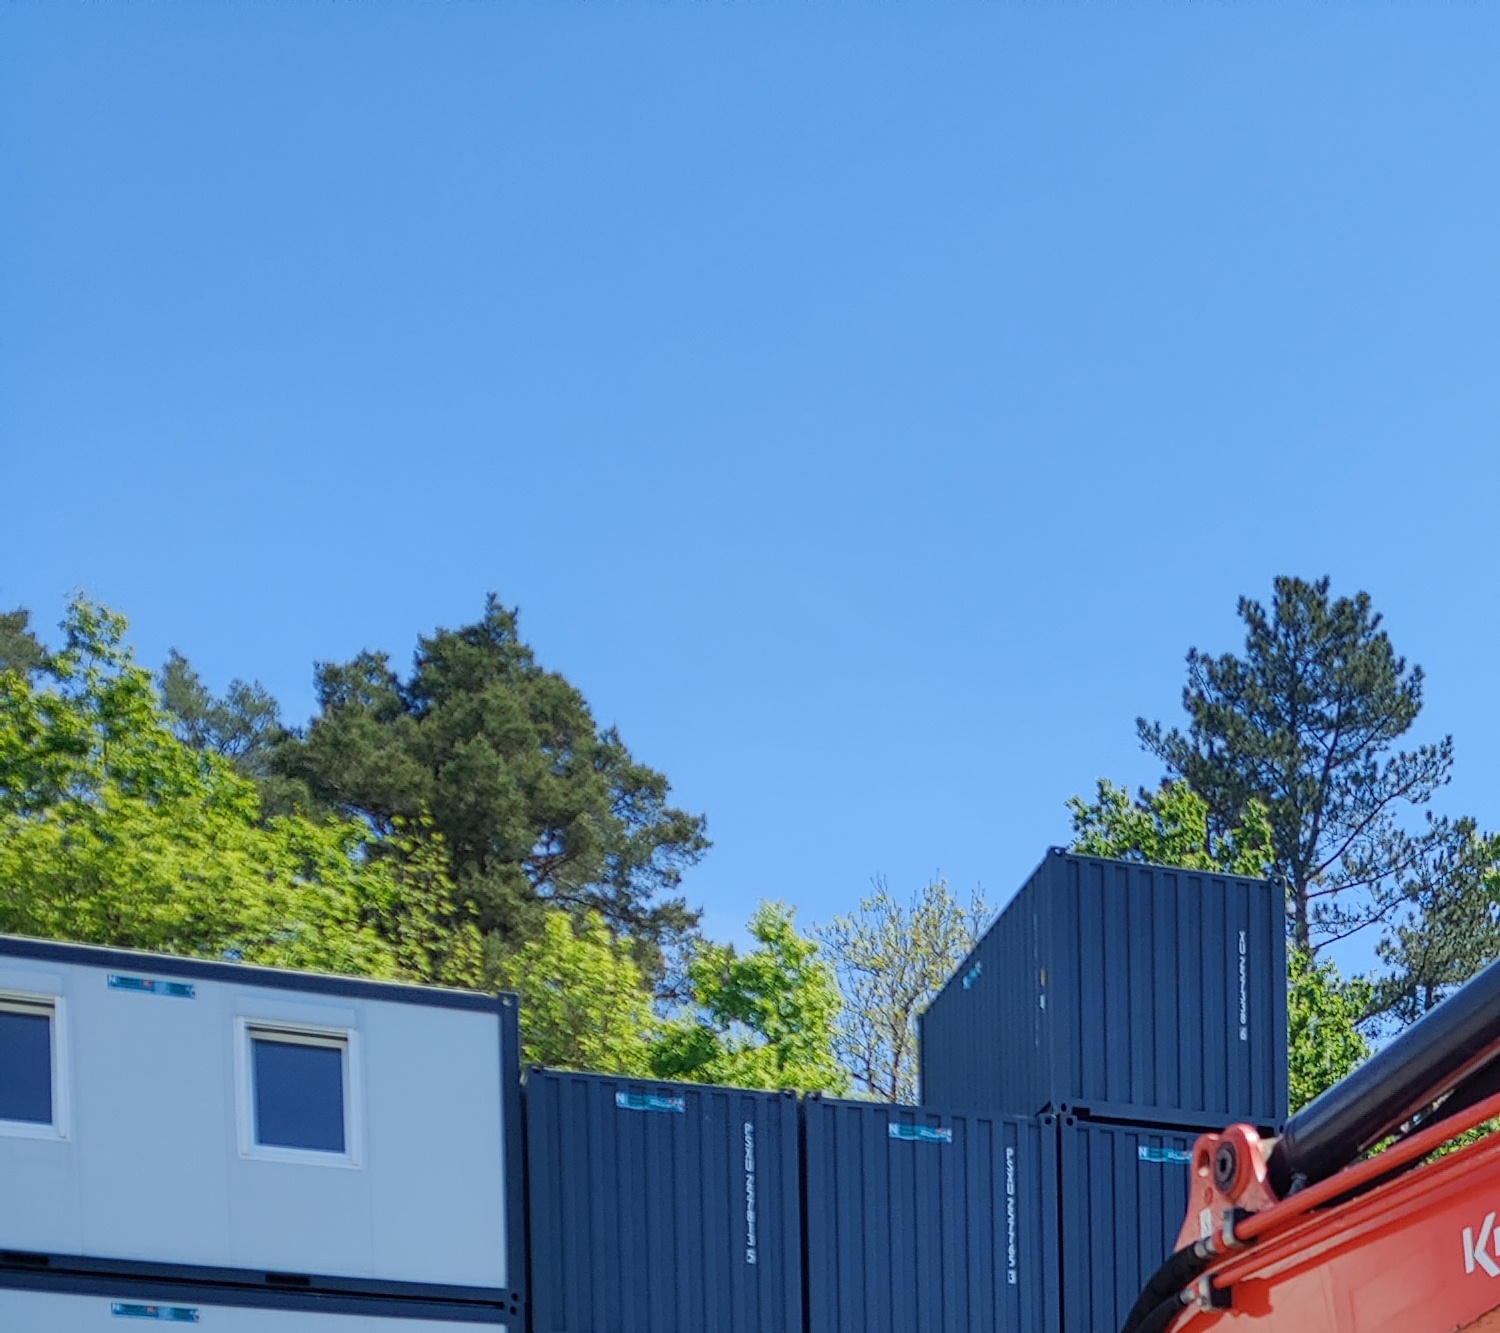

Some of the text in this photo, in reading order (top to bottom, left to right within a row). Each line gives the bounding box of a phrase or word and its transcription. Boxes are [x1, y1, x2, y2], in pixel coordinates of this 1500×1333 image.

[744, 1121, 755, 1172] PSXU
[1005, 1146, 1015, 1196] PSXU
[1006, 1197, 1016, 1268] 257765
